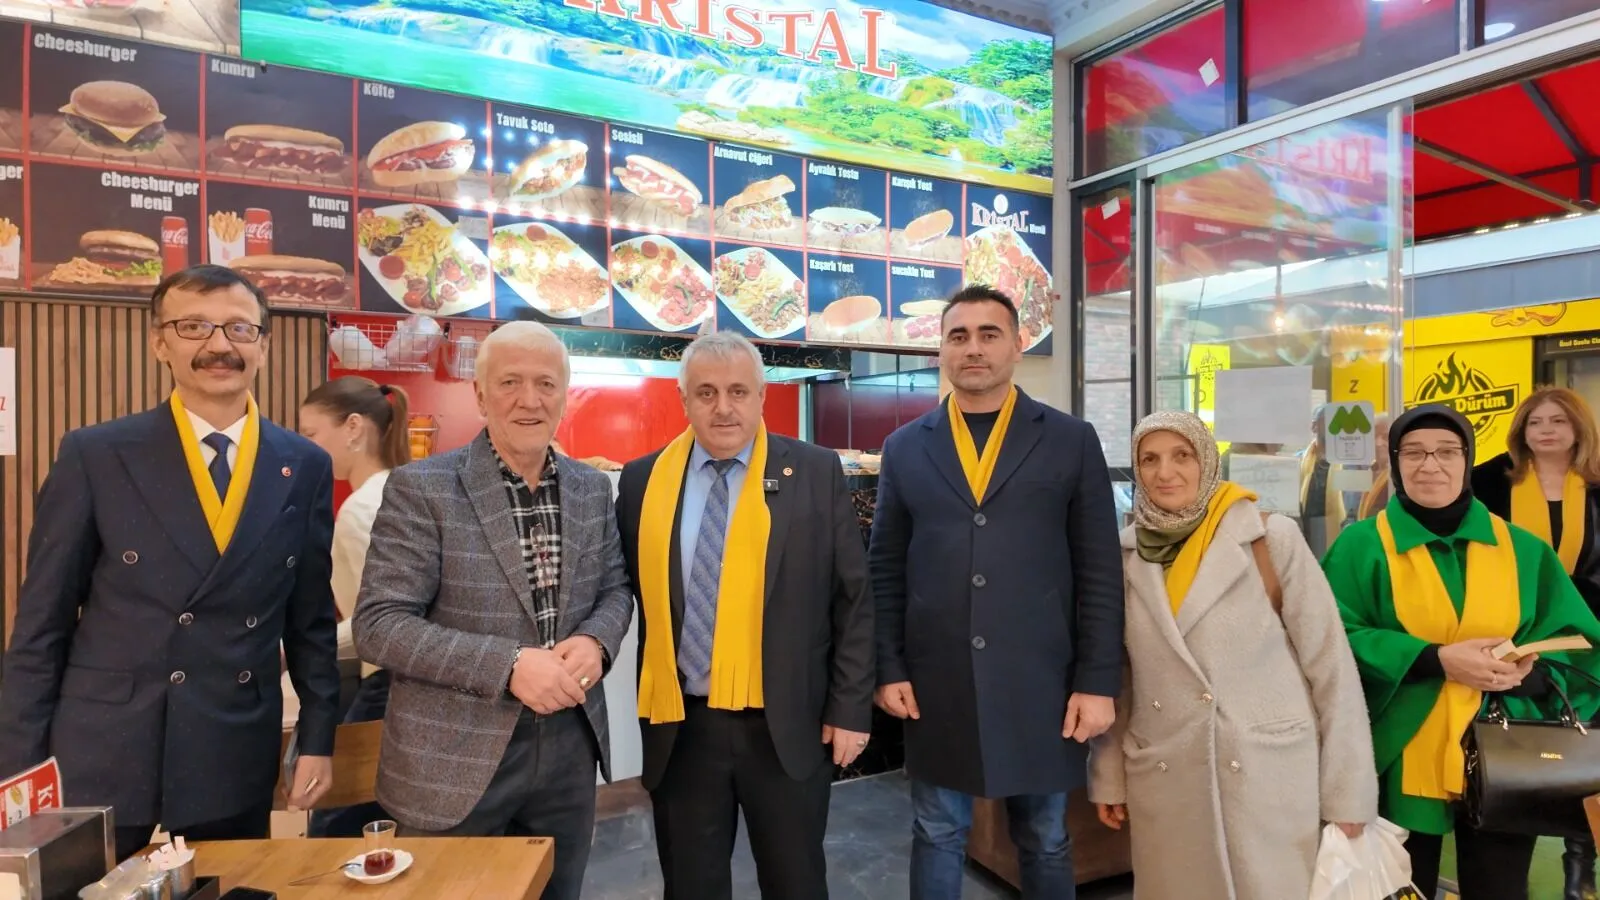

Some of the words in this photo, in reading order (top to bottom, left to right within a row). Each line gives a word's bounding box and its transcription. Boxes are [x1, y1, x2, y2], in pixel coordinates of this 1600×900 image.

[563, 0, 898, 80] RISTAL
[211, 59, 255, 78] Kumru
[363, 82, 395, 99] Köfte
[496, 112, 528, 130] Tavuk
[531, 118, 555, 134] Sote
[714, 146, 747, 162] Arnavut
[917, 179, 933, 192] Tost
[130, 193, 173, 212] Menü
[308, 195, 349, 213] Kumru
[312, 213, 346, 229] Menü
[838, 261, 854, 273] Tost
[919, 267, 935, 279] Tost
[1455, 393, 1507, 413] Dürüm
